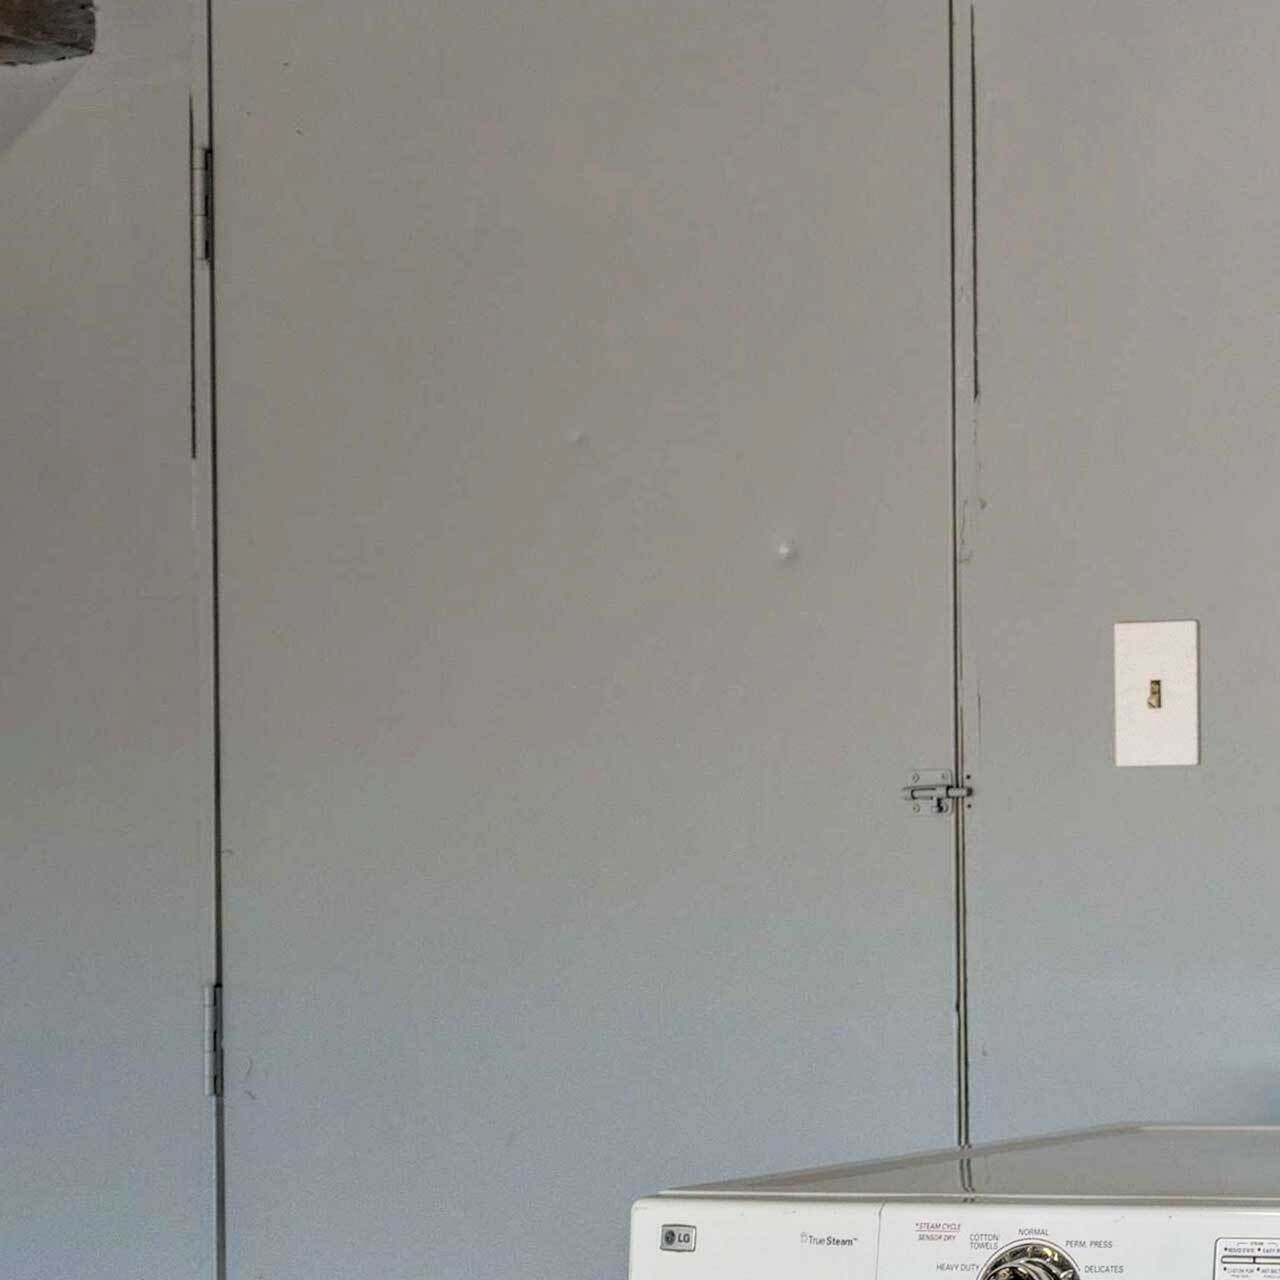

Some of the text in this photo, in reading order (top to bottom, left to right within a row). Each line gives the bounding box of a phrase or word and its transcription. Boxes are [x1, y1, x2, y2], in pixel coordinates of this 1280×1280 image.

[918, 1222, 941, 1230] STEAM
[1018, 1228, 1049, 1236] NORMAL
[677, 1232, 691, 1244] LG
[969, 1233, 999, 1242] COTTON
[970, 1242, 998, 1250] TOWELS
[1089, 1240, 1113, 1249] PRESS
[936, 1263, 980, 1272] HEAVY DUTY
[1084, 1265, 1124, 1274] DELICATES
